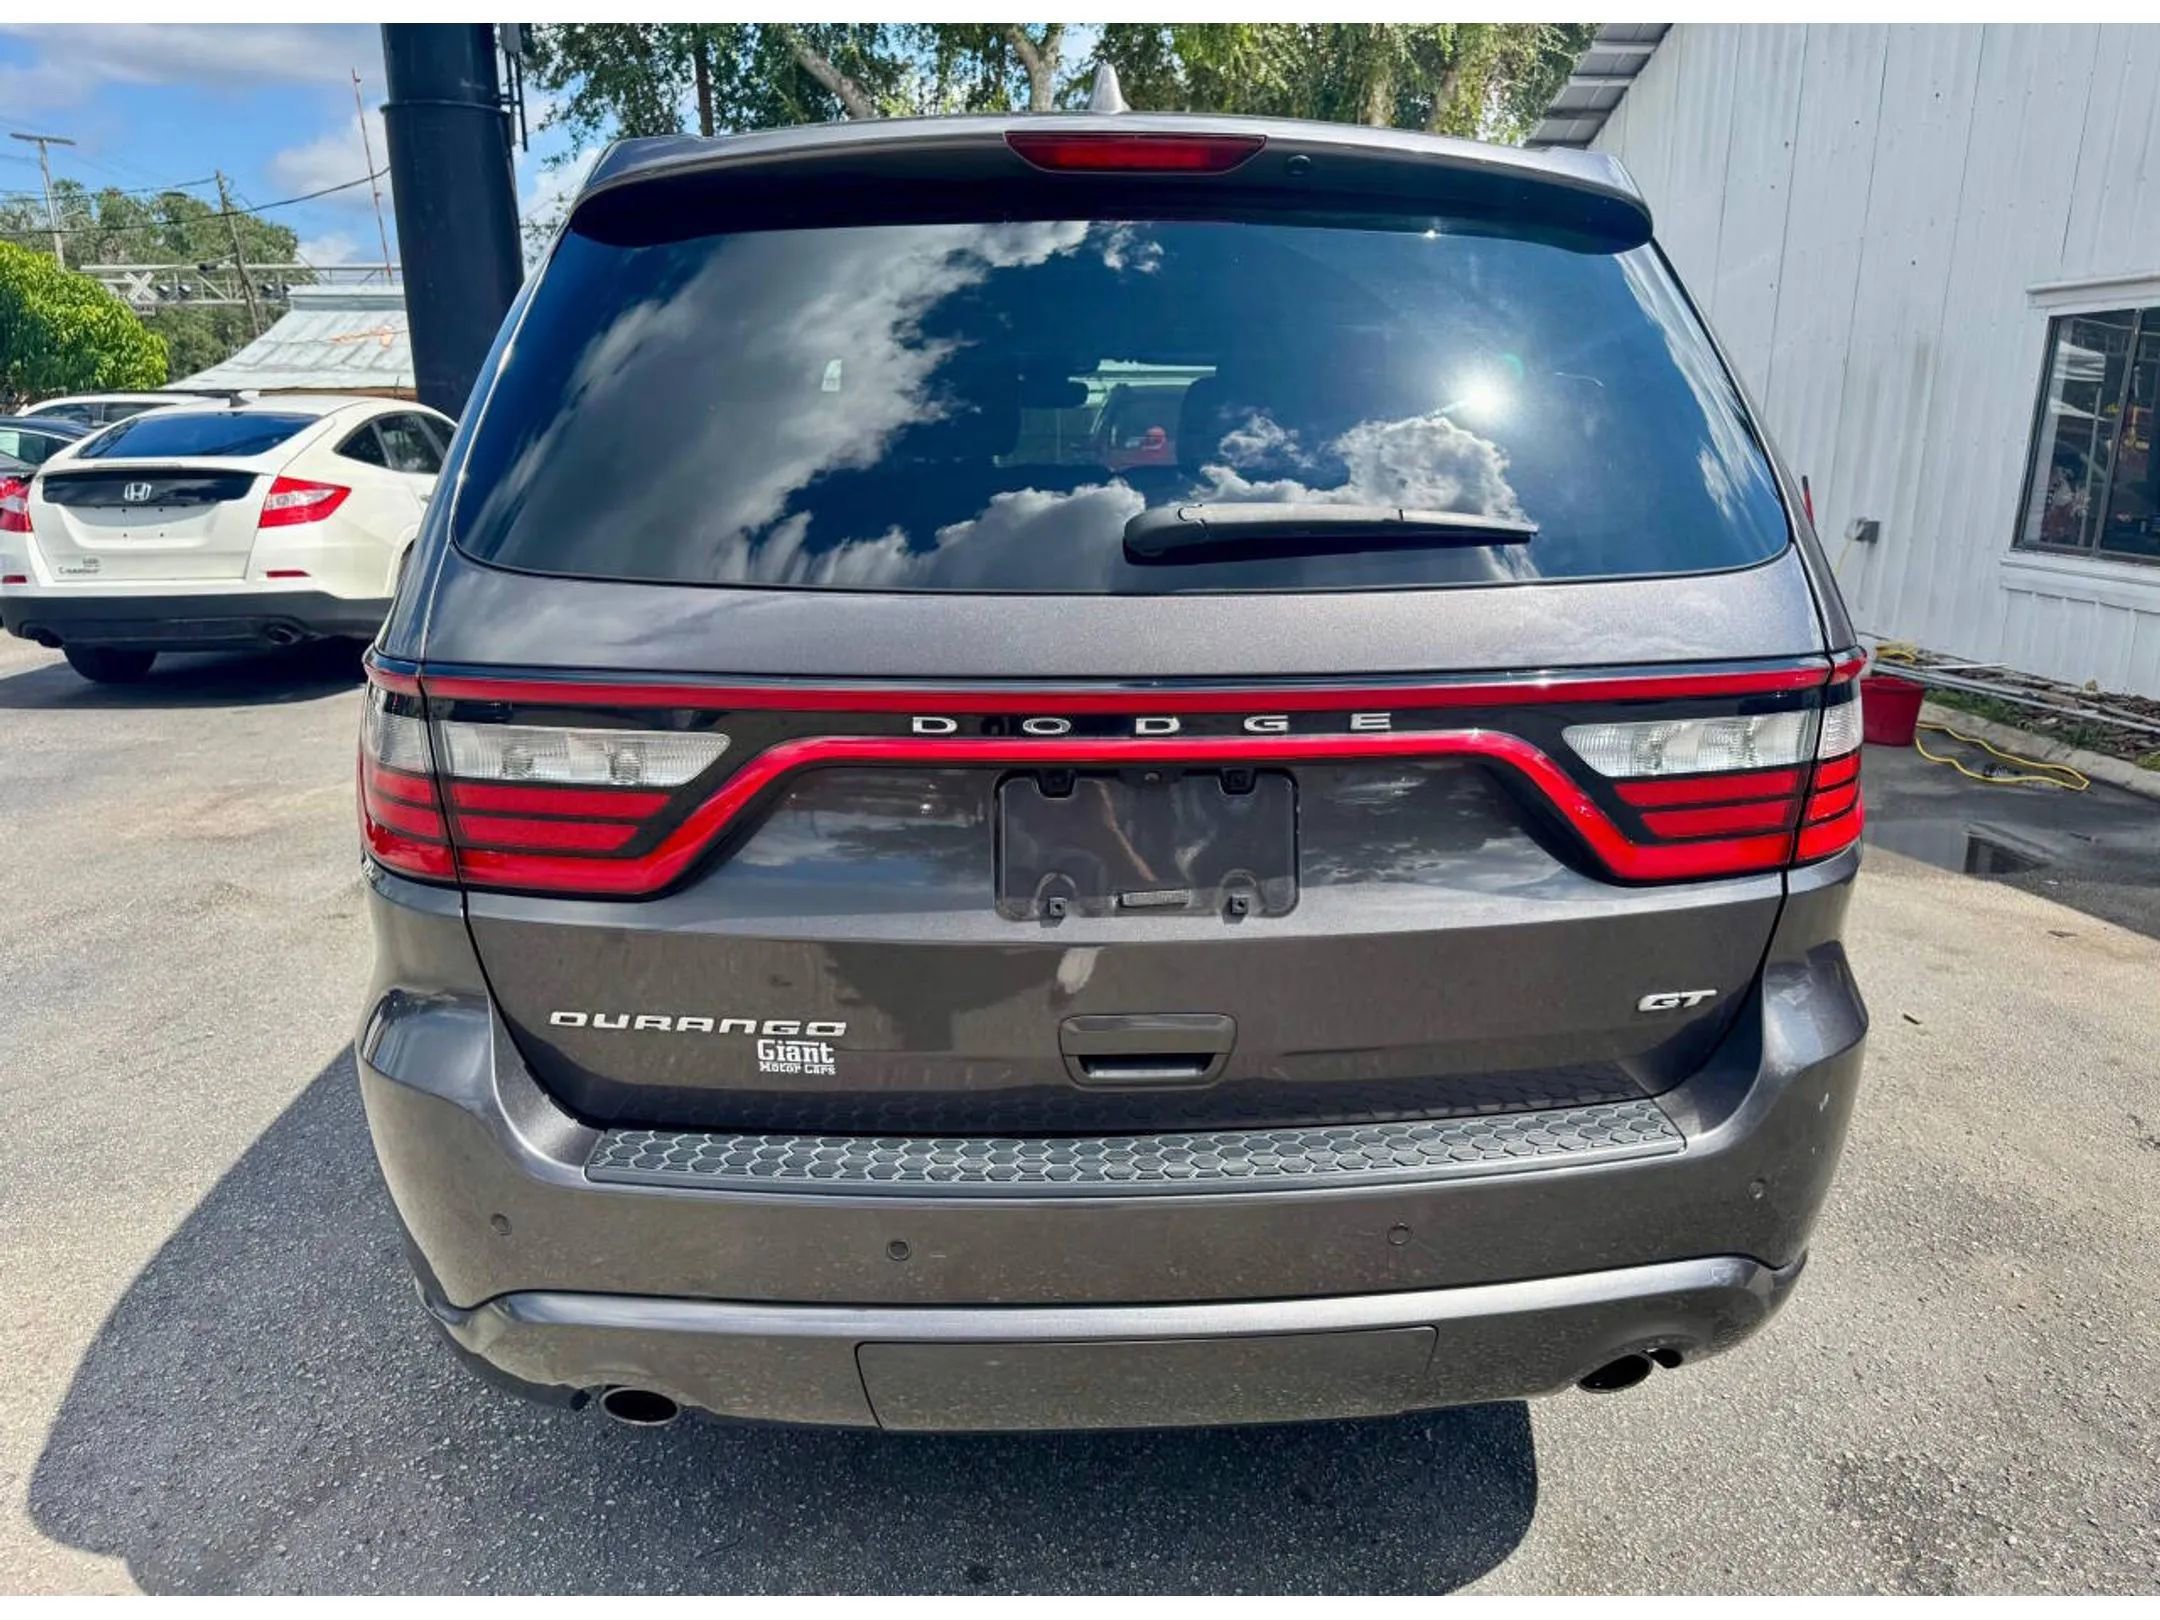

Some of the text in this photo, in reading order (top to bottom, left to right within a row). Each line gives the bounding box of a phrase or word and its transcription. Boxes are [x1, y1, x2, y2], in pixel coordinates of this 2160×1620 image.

[912, 712, 1392, 735] DODGE
[1638, 988, 1718, 1012] GT
[550, 1011, 847, 1037] DURANGO
[757, 1039, 835, 1064] Giant
[759, 1061, 837, 1075] Motor Cars
